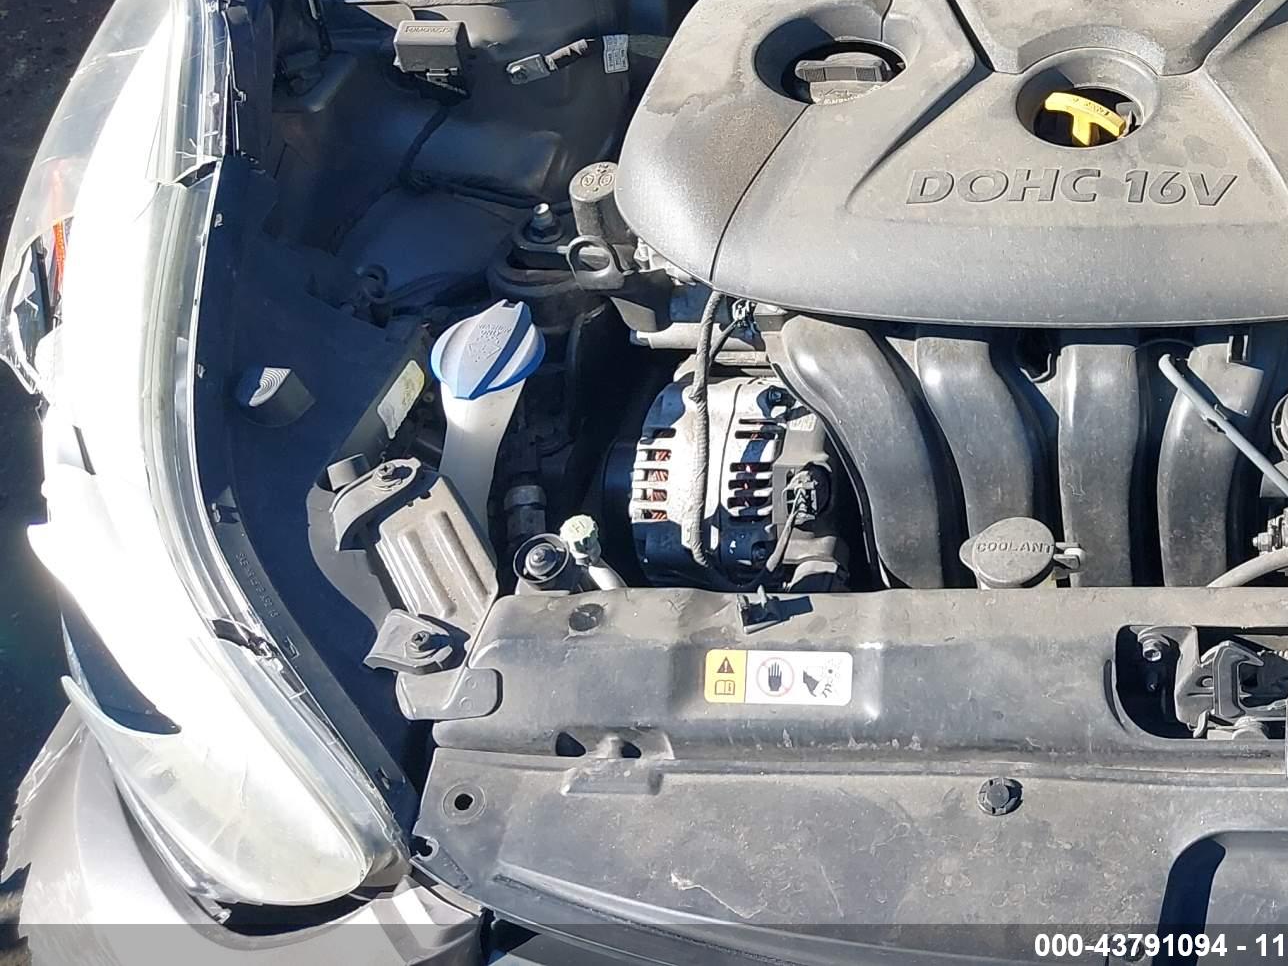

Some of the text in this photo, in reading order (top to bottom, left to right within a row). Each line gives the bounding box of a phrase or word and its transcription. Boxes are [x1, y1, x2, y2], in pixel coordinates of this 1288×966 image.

[906, 168, 1238, 207] DOHC 16V
[977, 538, 1052, 554] COOLANT
